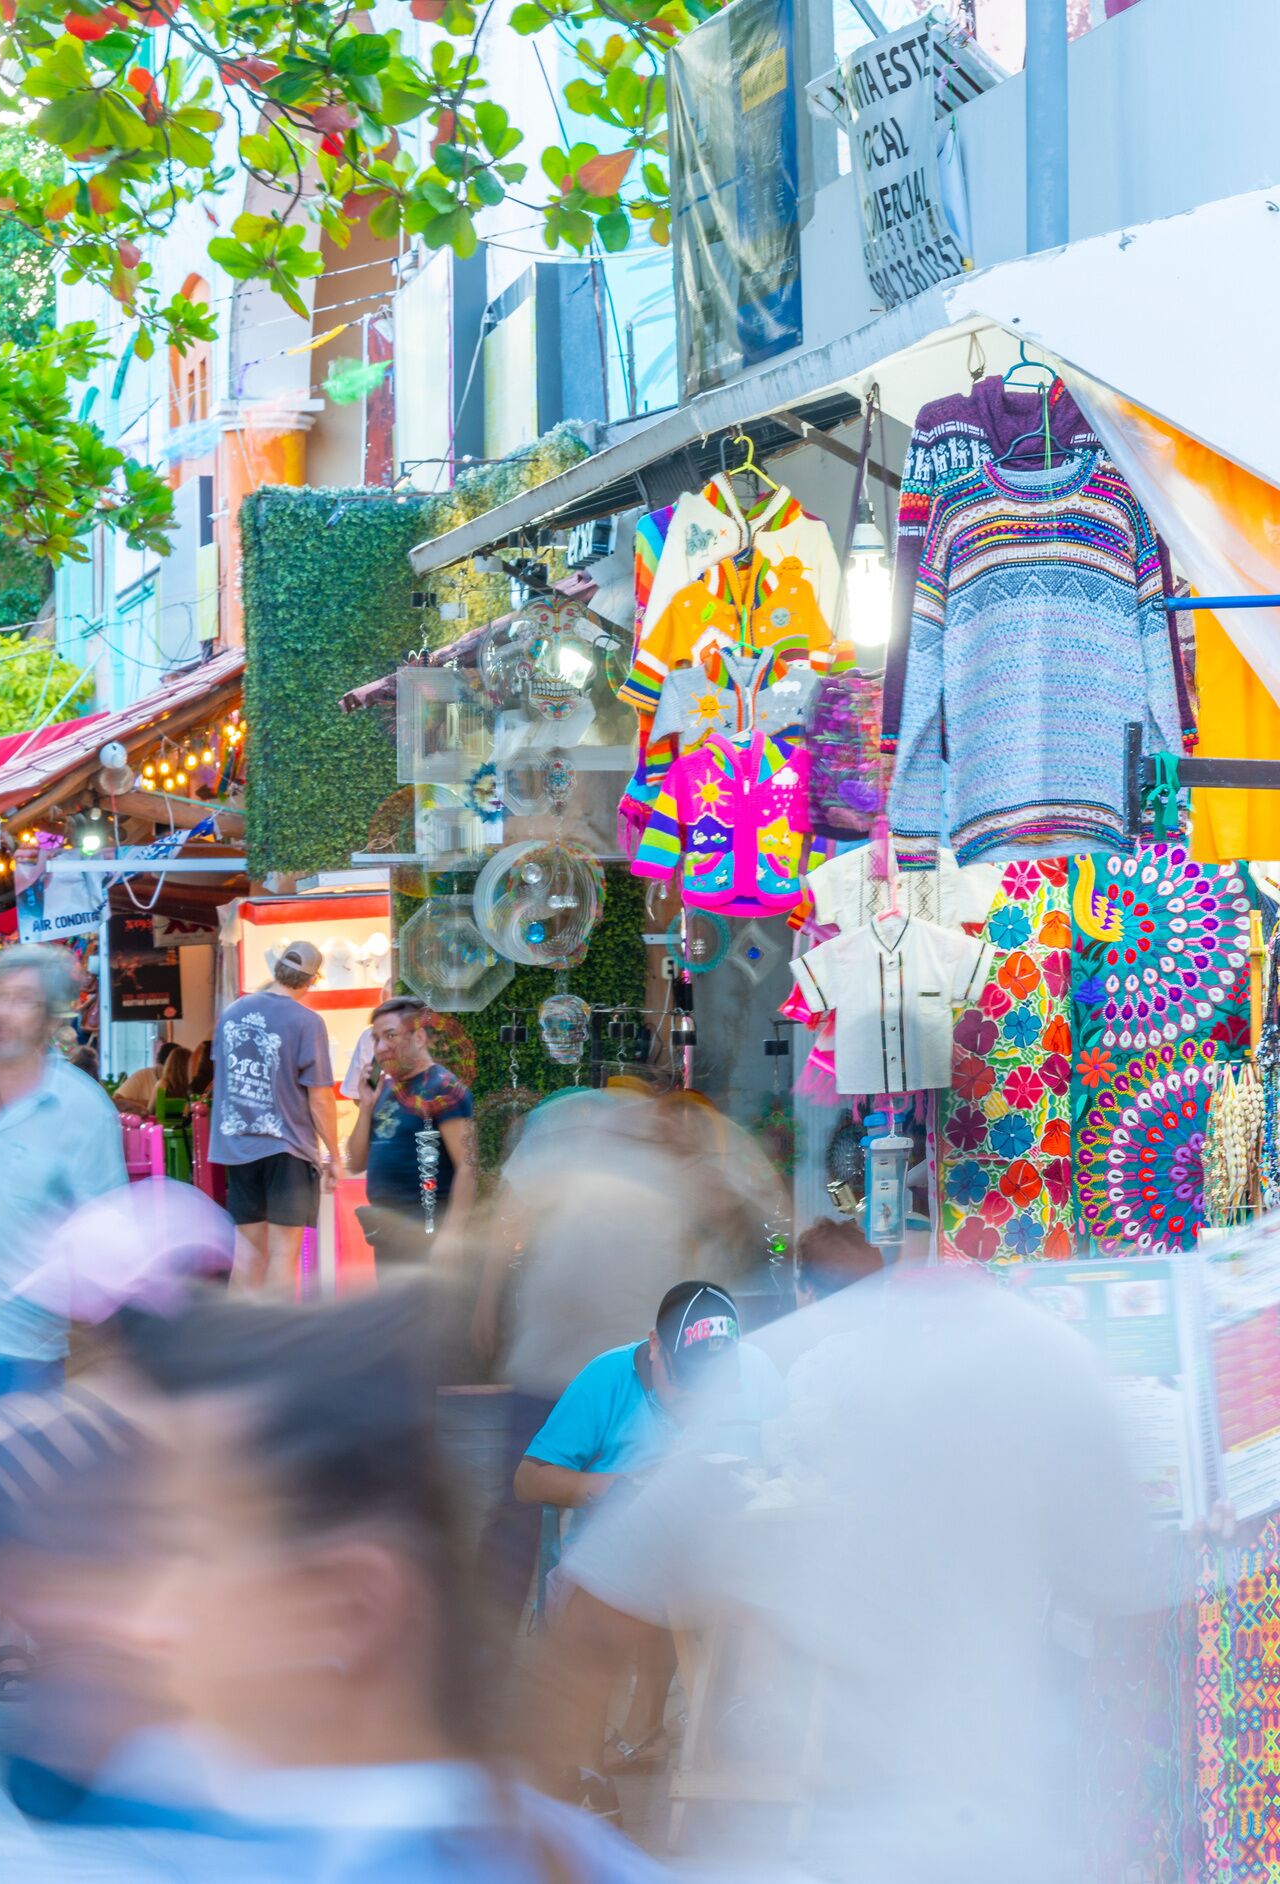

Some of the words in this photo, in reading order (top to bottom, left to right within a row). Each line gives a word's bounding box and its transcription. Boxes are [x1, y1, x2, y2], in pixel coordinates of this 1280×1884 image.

[875, 33, 931, 95] ESTE
[857, 117, 909, 172] OCAL
[33, 918, 52, 932] AIR
